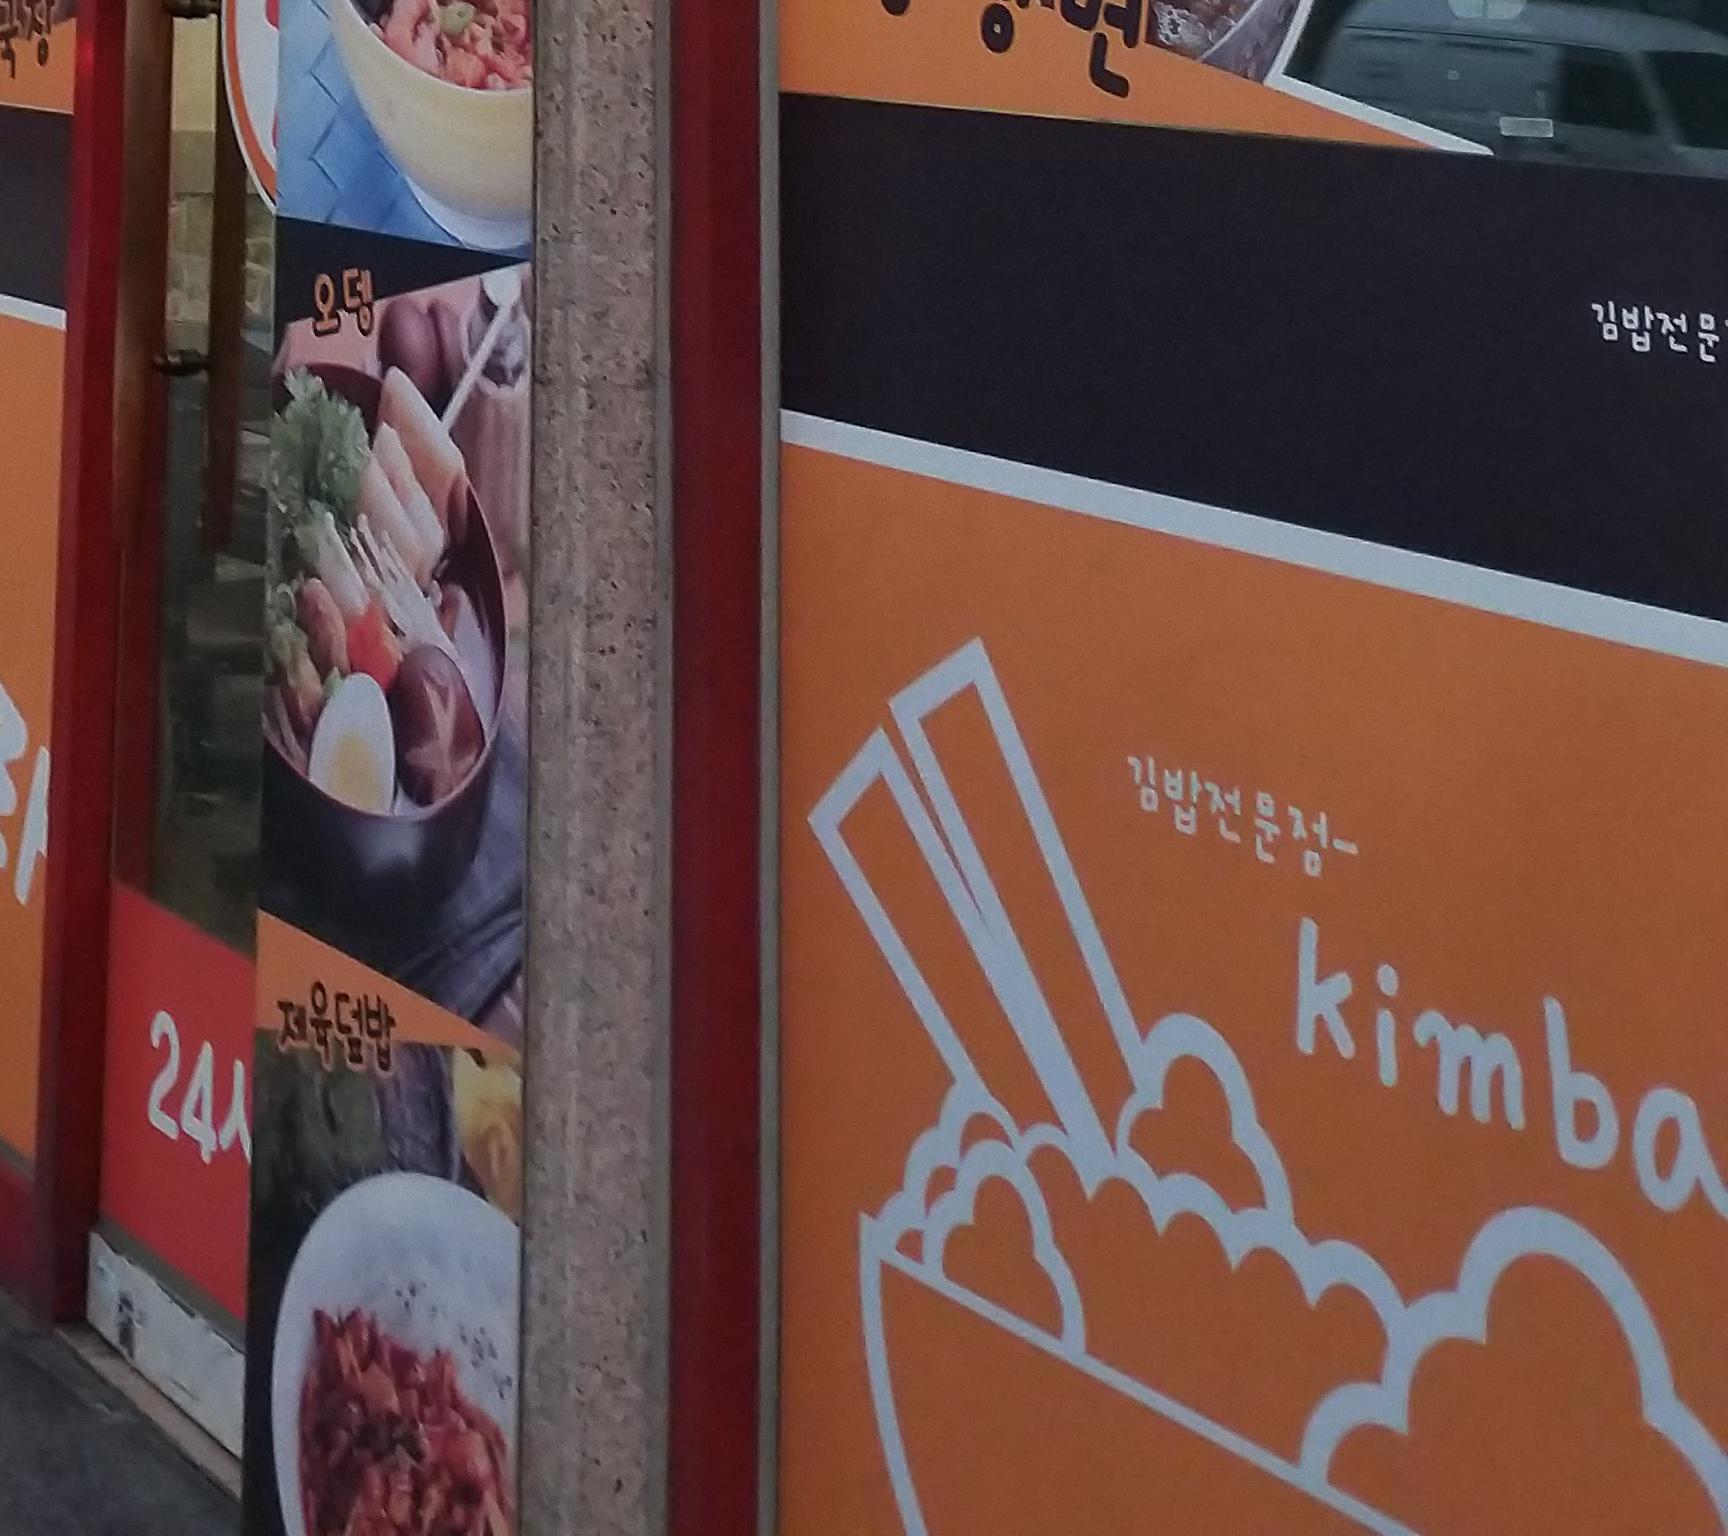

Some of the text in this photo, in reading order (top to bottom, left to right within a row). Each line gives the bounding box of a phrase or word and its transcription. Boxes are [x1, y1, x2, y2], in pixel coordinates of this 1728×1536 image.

[311, 266, 375, 338] 오뎅
[1591, 300, 1728, 363] 김밥전문
[276, 980, 397, 1073] 제육덮밥
